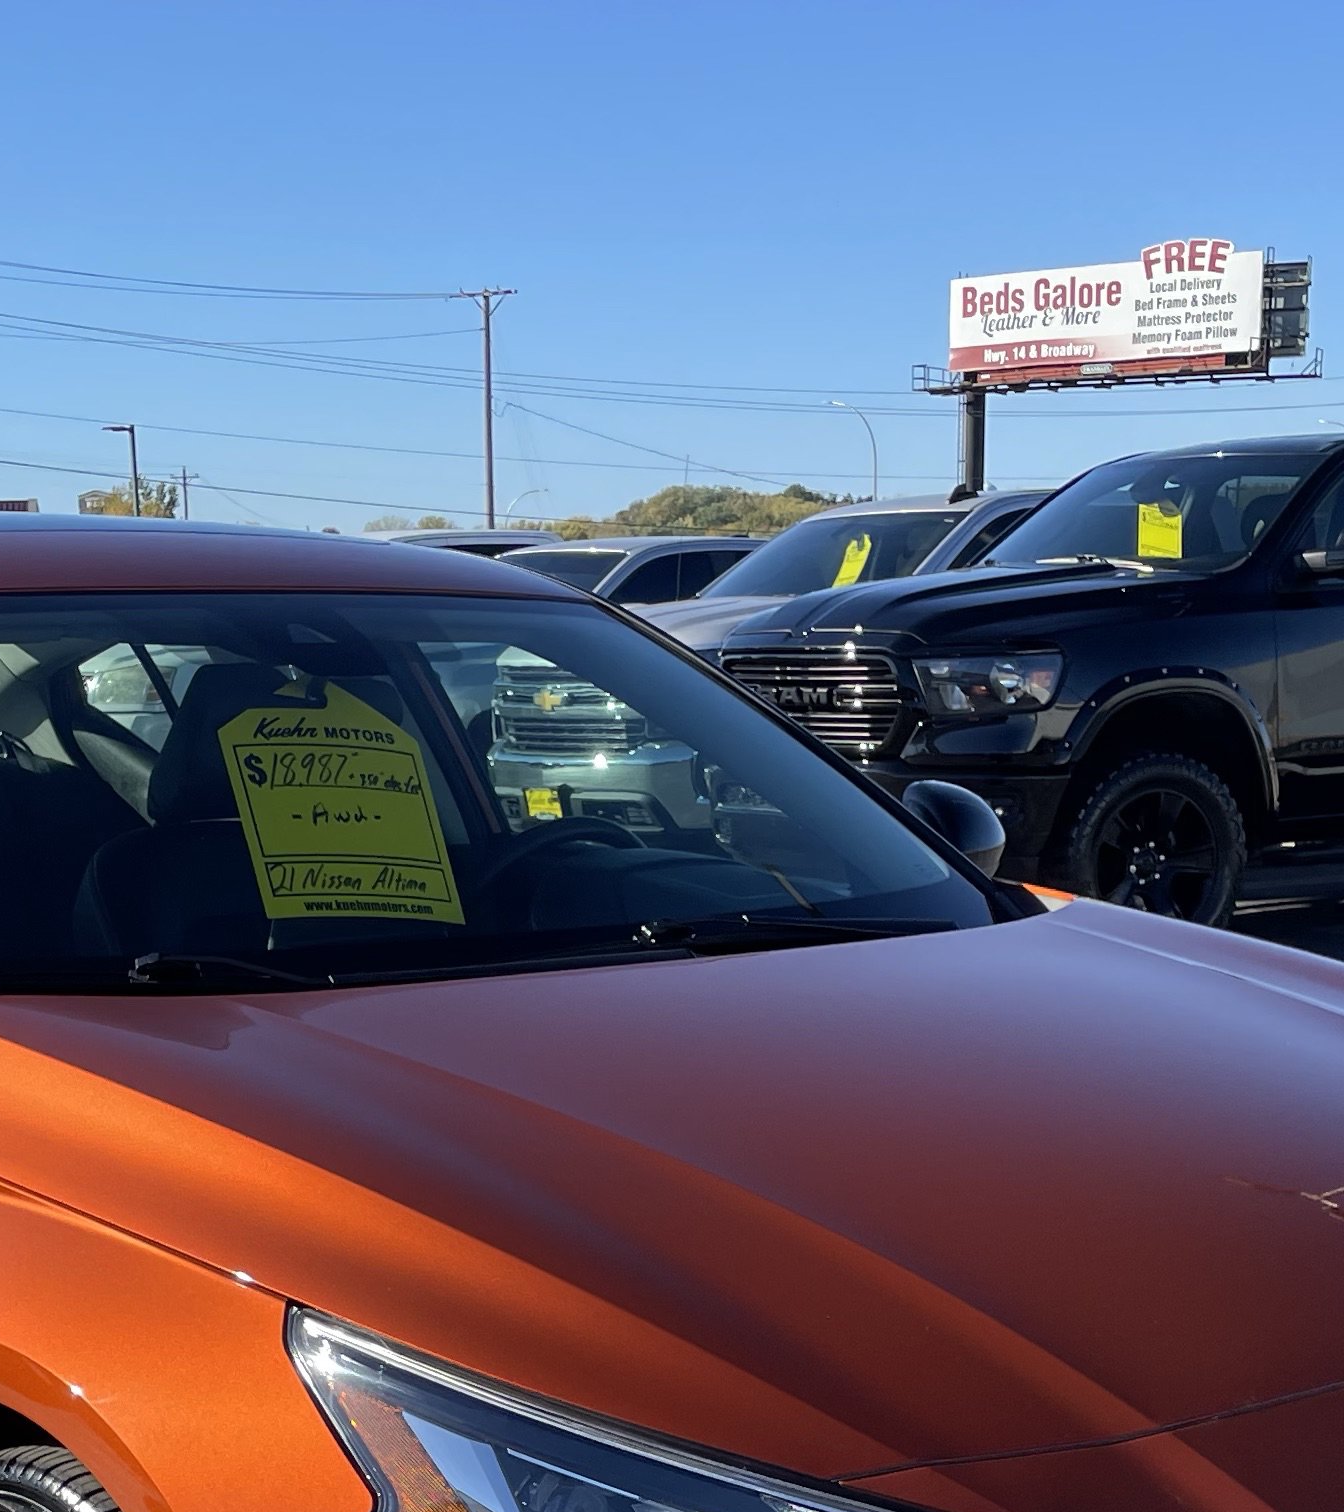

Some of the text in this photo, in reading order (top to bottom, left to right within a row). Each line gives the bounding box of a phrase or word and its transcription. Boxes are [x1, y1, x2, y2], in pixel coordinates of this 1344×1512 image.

[1142, 240, 1231, 280] FREE
[962, 276, 1122, 318] Beds Galore
[1149, 278, 1222, 293] Local Delivery
[1134, 291, 1237, 311] Bed Frame & Sheets
[981, 306, 1101, 338] Leather & More
[1137, 309, 1234, 328] Mattress Protector
[1132, 325, 1238, 345] Memory Foam Pillow
[983, 341, 1095, 365] Hwy. 14 & Broadway
[254, 716, 396, 745] Kuehn MOTORS
[270, 863, 427, 893] 21 Nissan Altima
[304, 899, 434, 915] www.kuehnmotors.com
